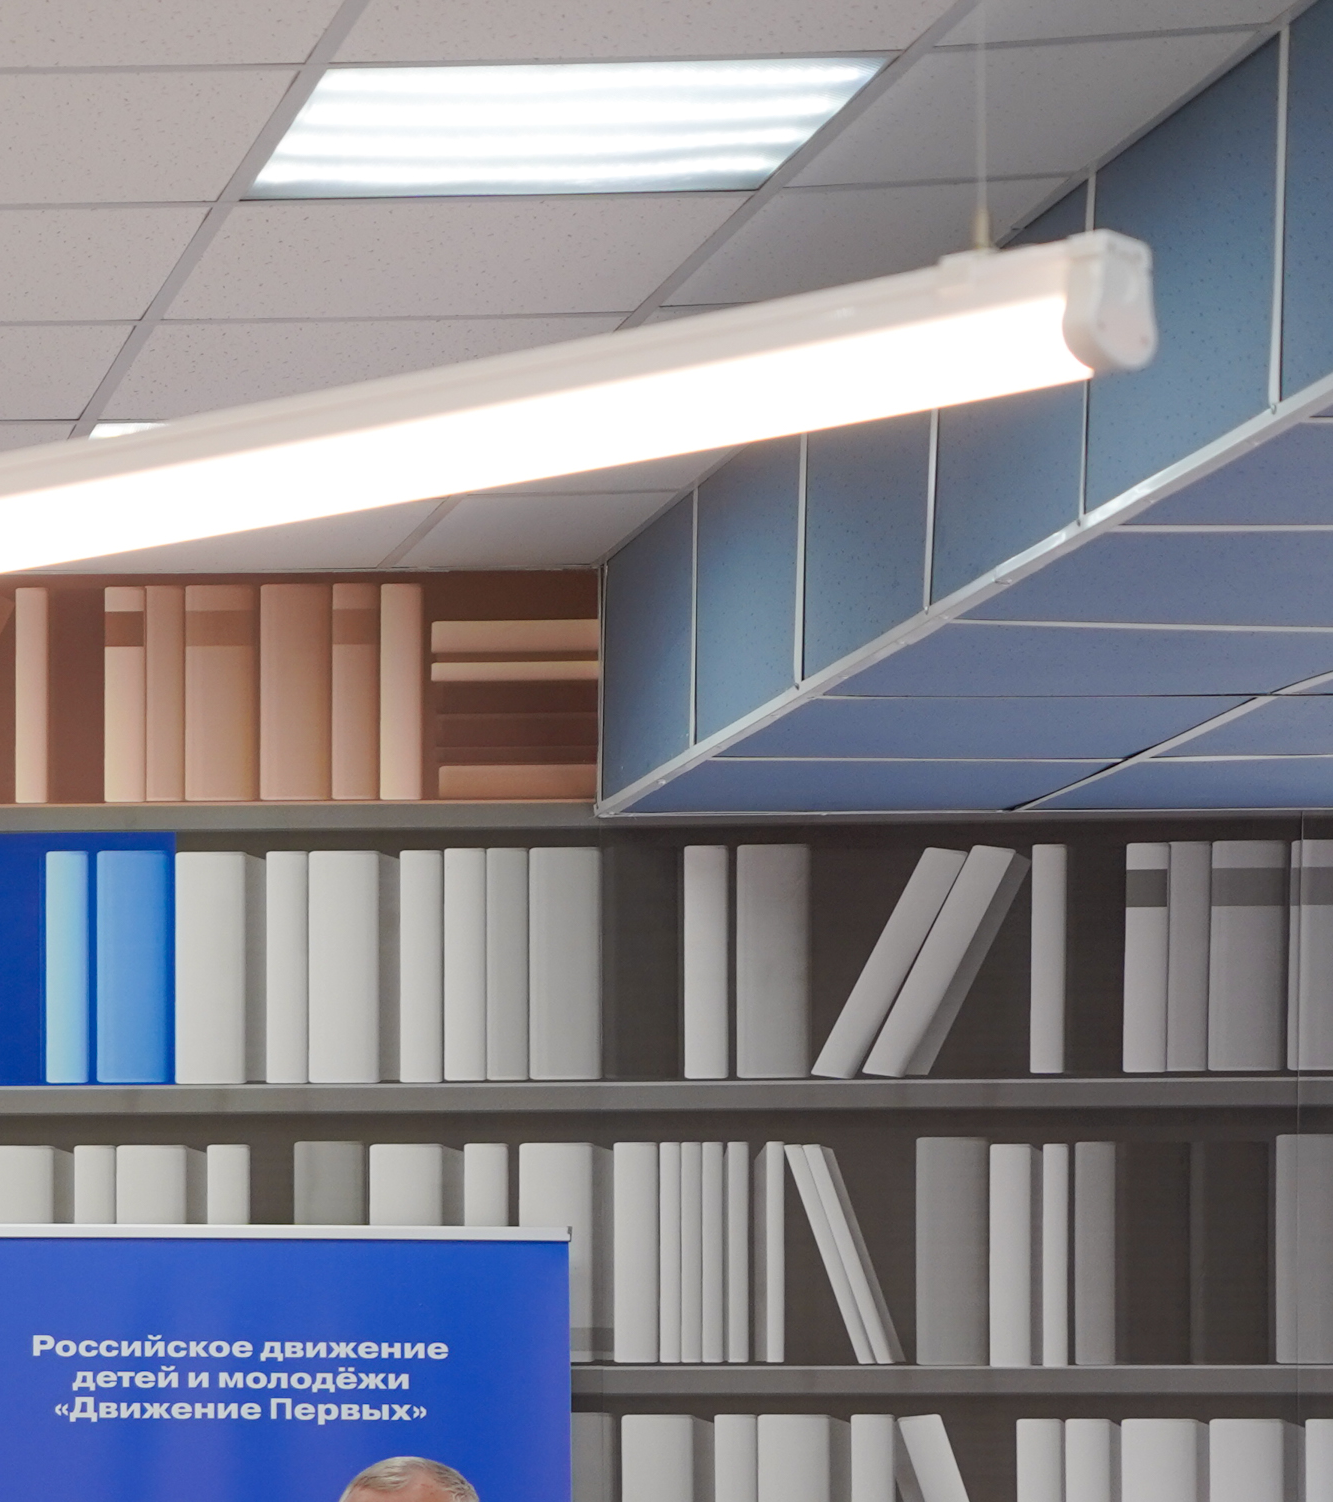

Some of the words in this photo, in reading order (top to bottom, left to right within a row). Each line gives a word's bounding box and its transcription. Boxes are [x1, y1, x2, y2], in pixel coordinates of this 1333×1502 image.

[32, 1334, 253, 1358] Российское
[260, 1340, 449, 1361] движение
[72, 1366, 179, 1391] детей
[188, 1371, 210, 1388] и
[219, 1367, 410, 1392] молодёжи
[54, 1396, 262, 1422] «Движение
[270, 1397, 427, 1425] Первых»
